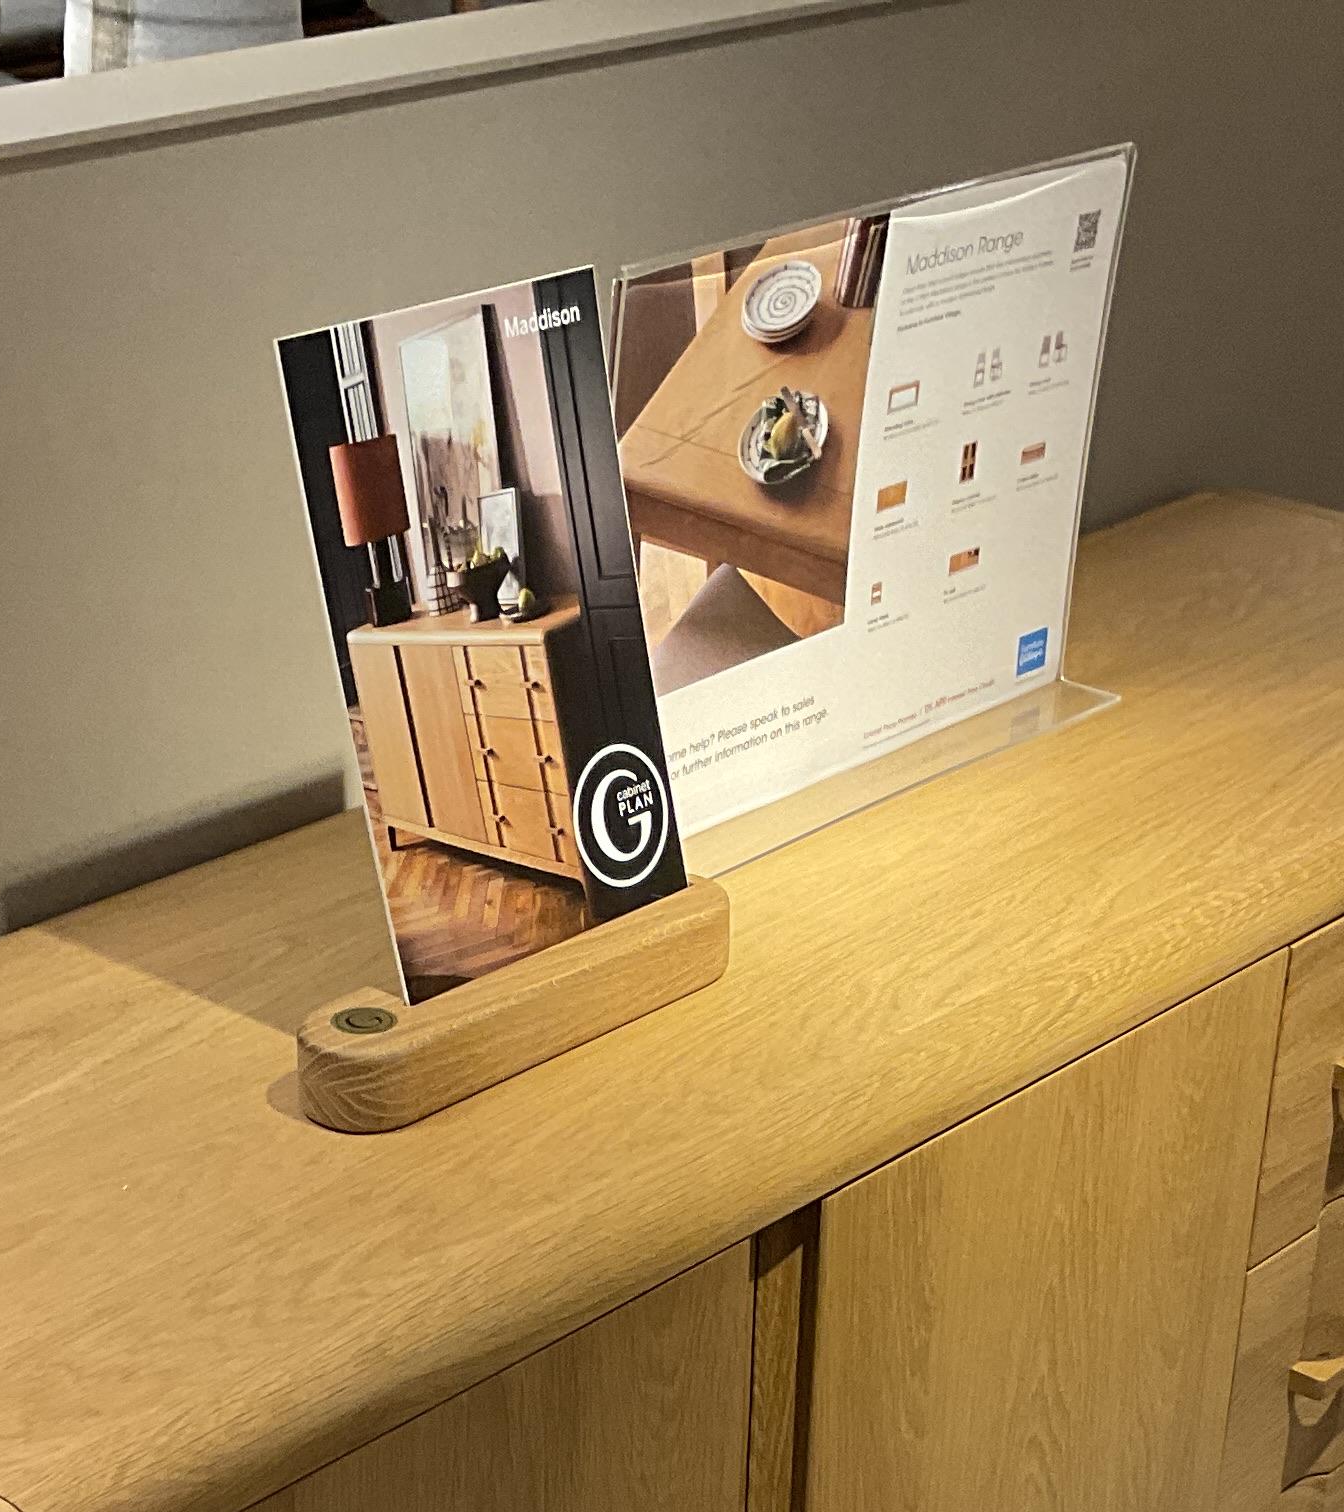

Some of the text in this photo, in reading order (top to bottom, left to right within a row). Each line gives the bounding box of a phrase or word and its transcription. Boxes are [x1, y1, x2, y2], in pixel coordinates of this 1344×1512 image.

[905, 242, 975, 275] Maddison
[977, 230, 1024, 254] Range
[503, 304, 581, 337] Maddison
[689, 734, 716, 755] help?
[717, 722, 748, 743] Please
[749, 709, 779, 731] speak
[781, 704, 791, 718] to
[792, 695, 816, 713] sales
[682, 754, 713, 776] further
[714, 732, 769, 763] information
[770, 727, 783, 741] on
[784, 720, 801, 736] this
[616, 778, 650, 802] cabinet
[618, 790, 654, 817] PLAN
[590, 768, 653, 862] G
